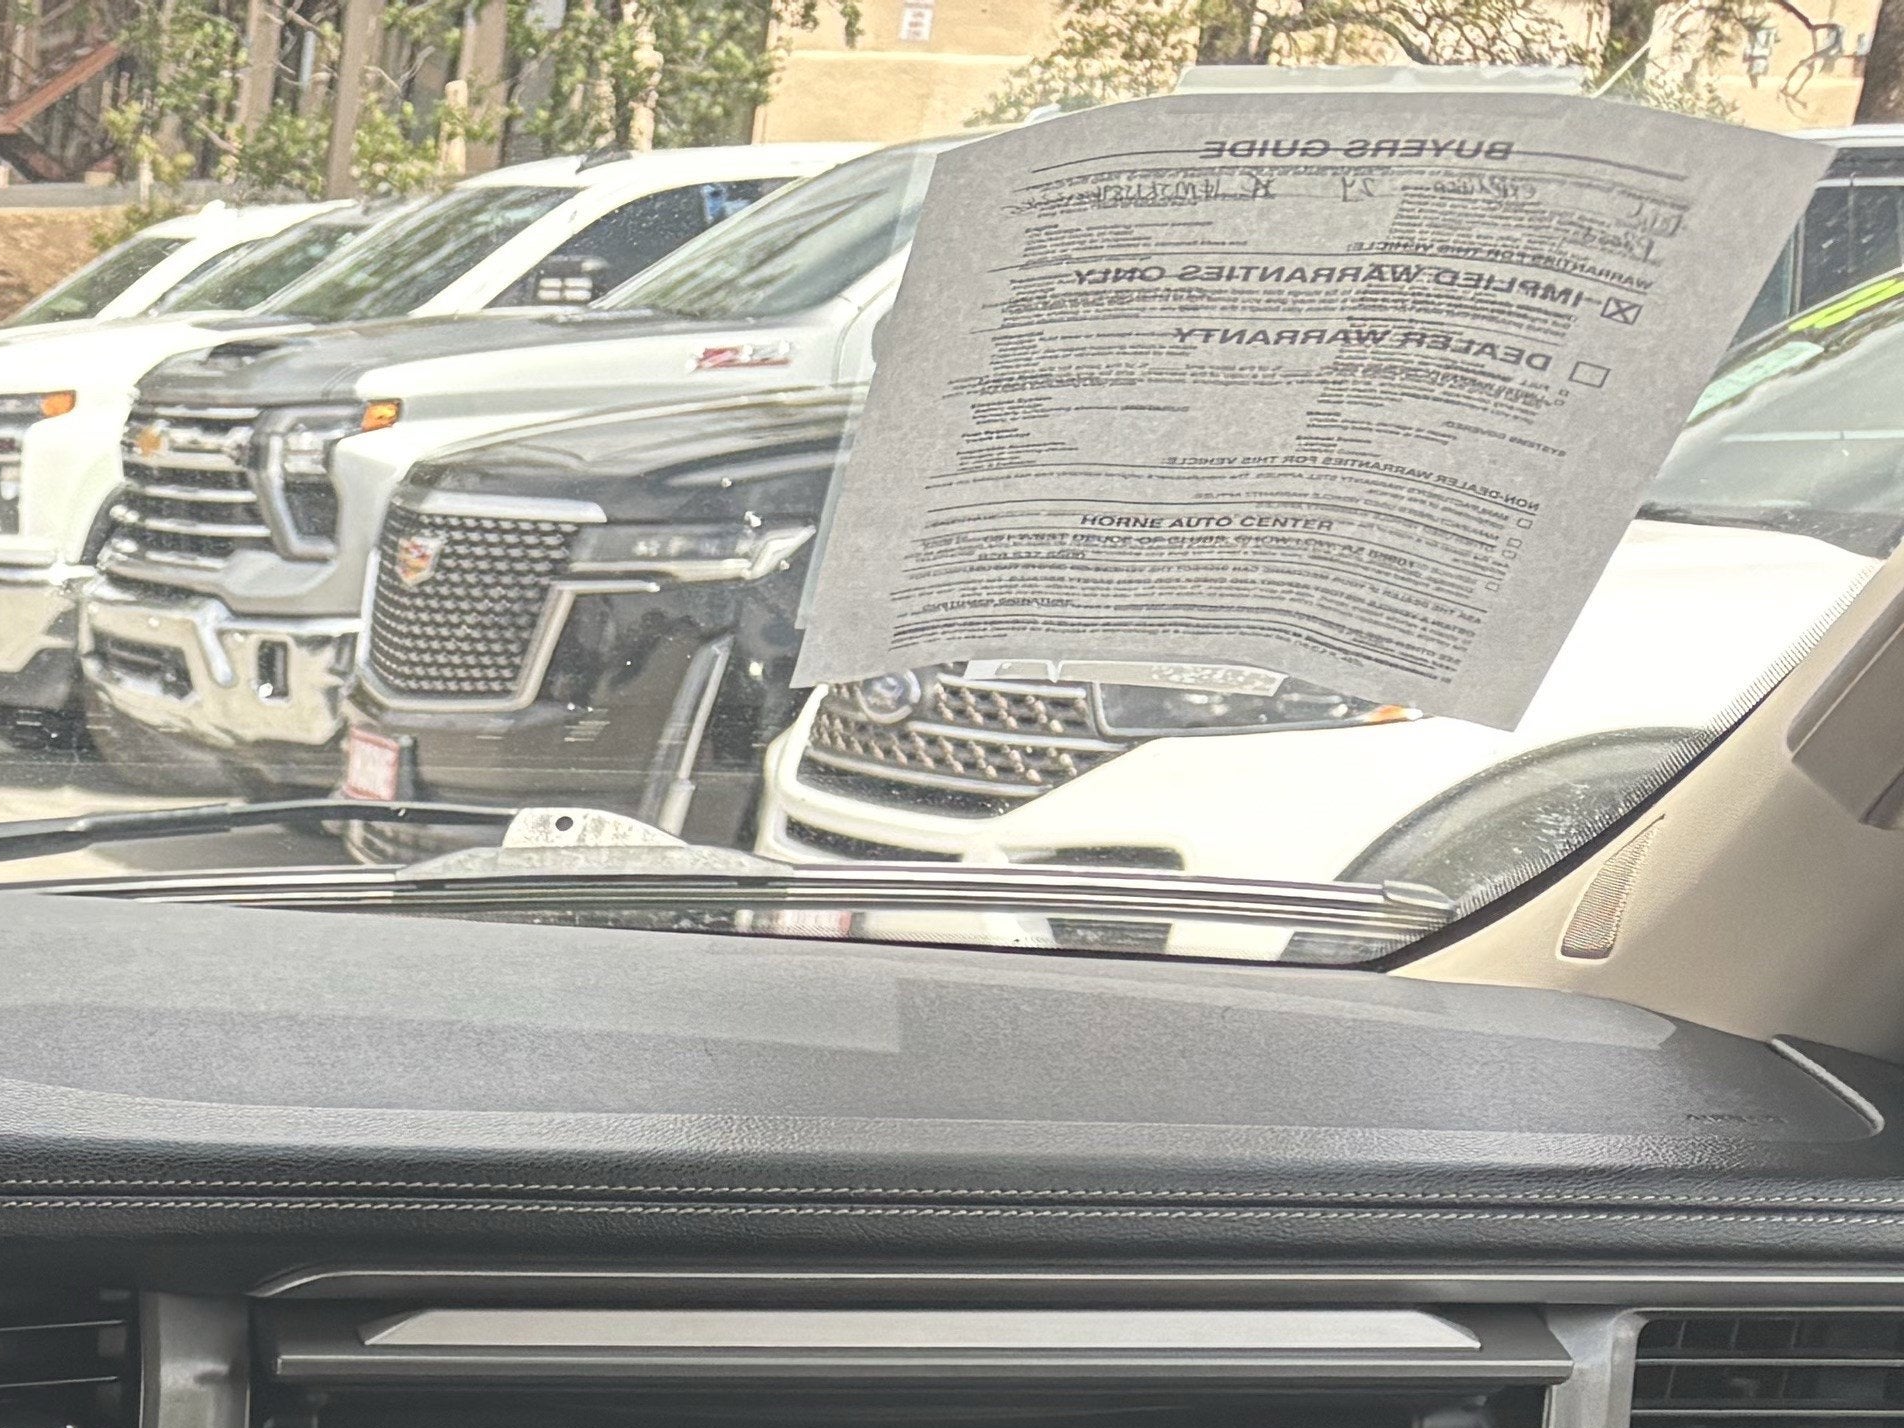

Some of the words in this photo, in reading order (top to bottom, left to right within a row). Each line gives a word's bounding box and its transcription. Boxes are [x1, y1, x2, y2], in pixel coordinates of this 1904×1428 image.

[1080, 514, 1164, 529] HORNE
[1169, 515, 1233, 528] AUTO
[1240, 514, 1335, 532] CENTER
